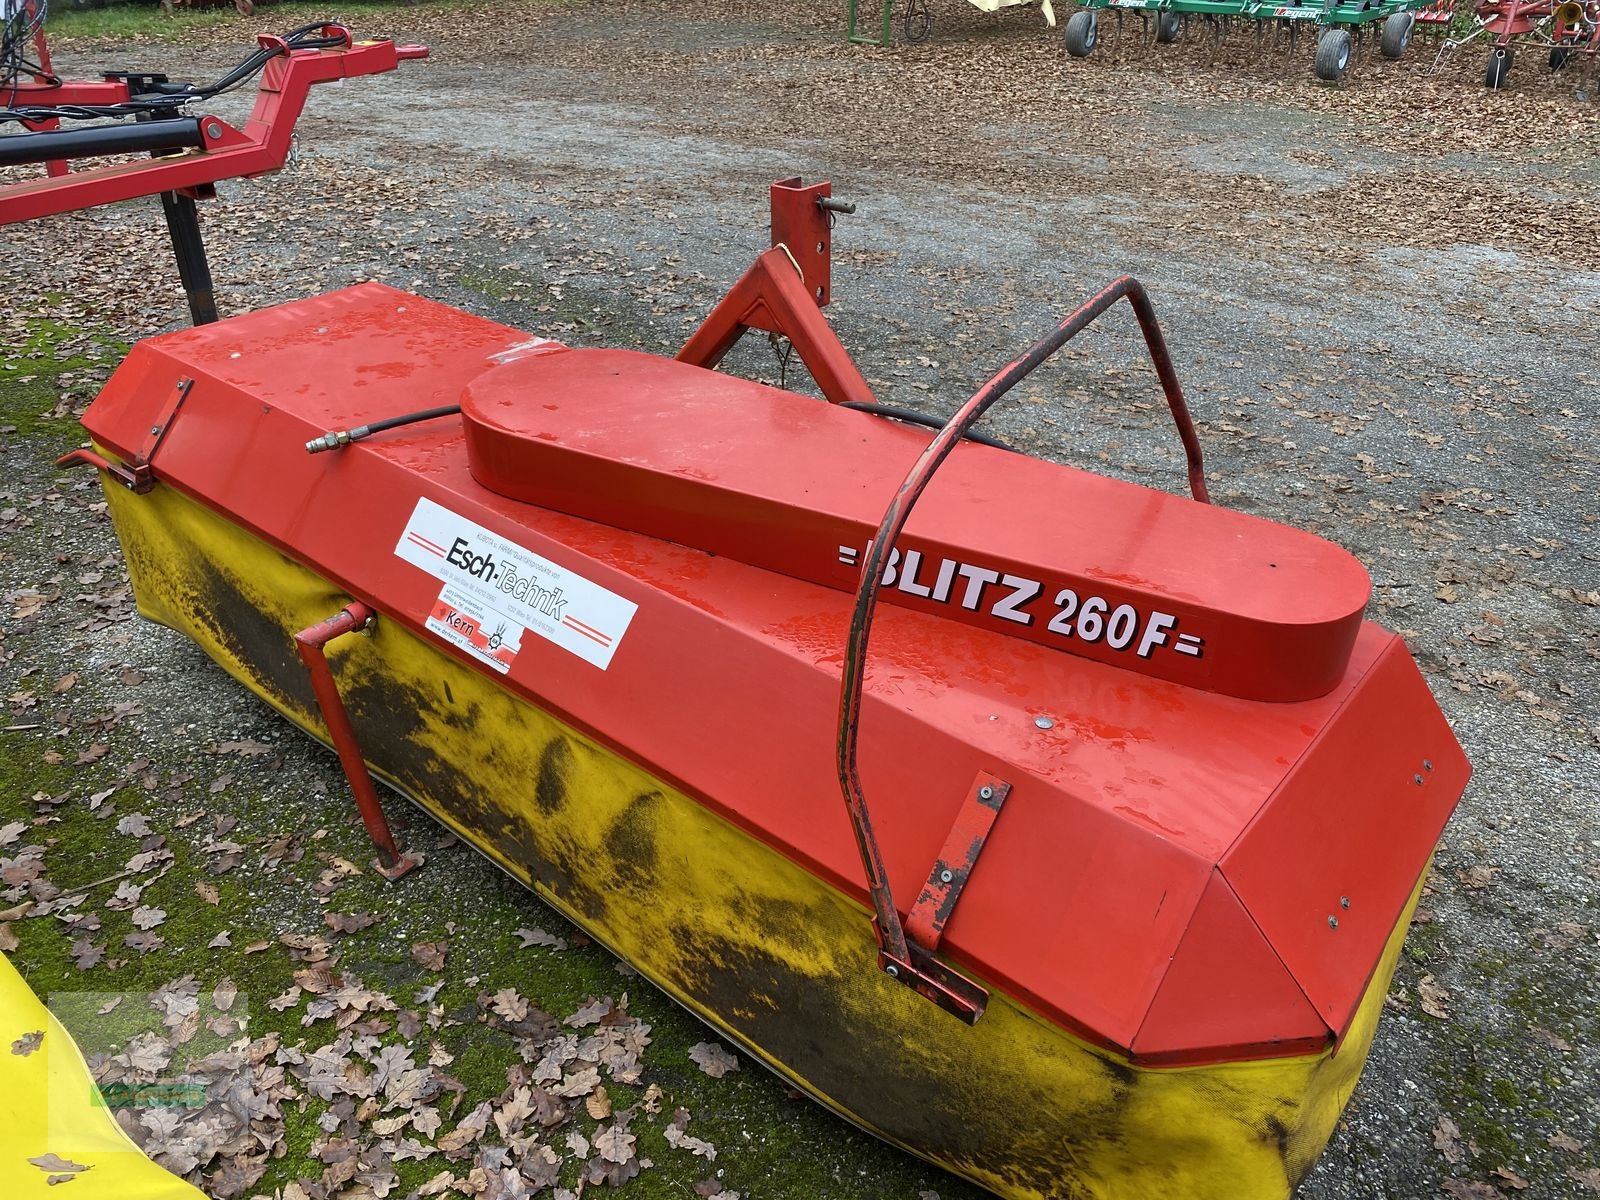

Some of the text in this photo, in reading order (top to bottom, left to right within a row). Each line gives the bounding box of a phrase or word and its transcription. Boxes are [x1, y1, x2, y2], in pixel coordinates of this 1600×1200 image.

[446, 536, 568, 621] Esch-Technik
[446, 610, 474, 636] Kern
[1048, 589, 1175, 657] 260F
